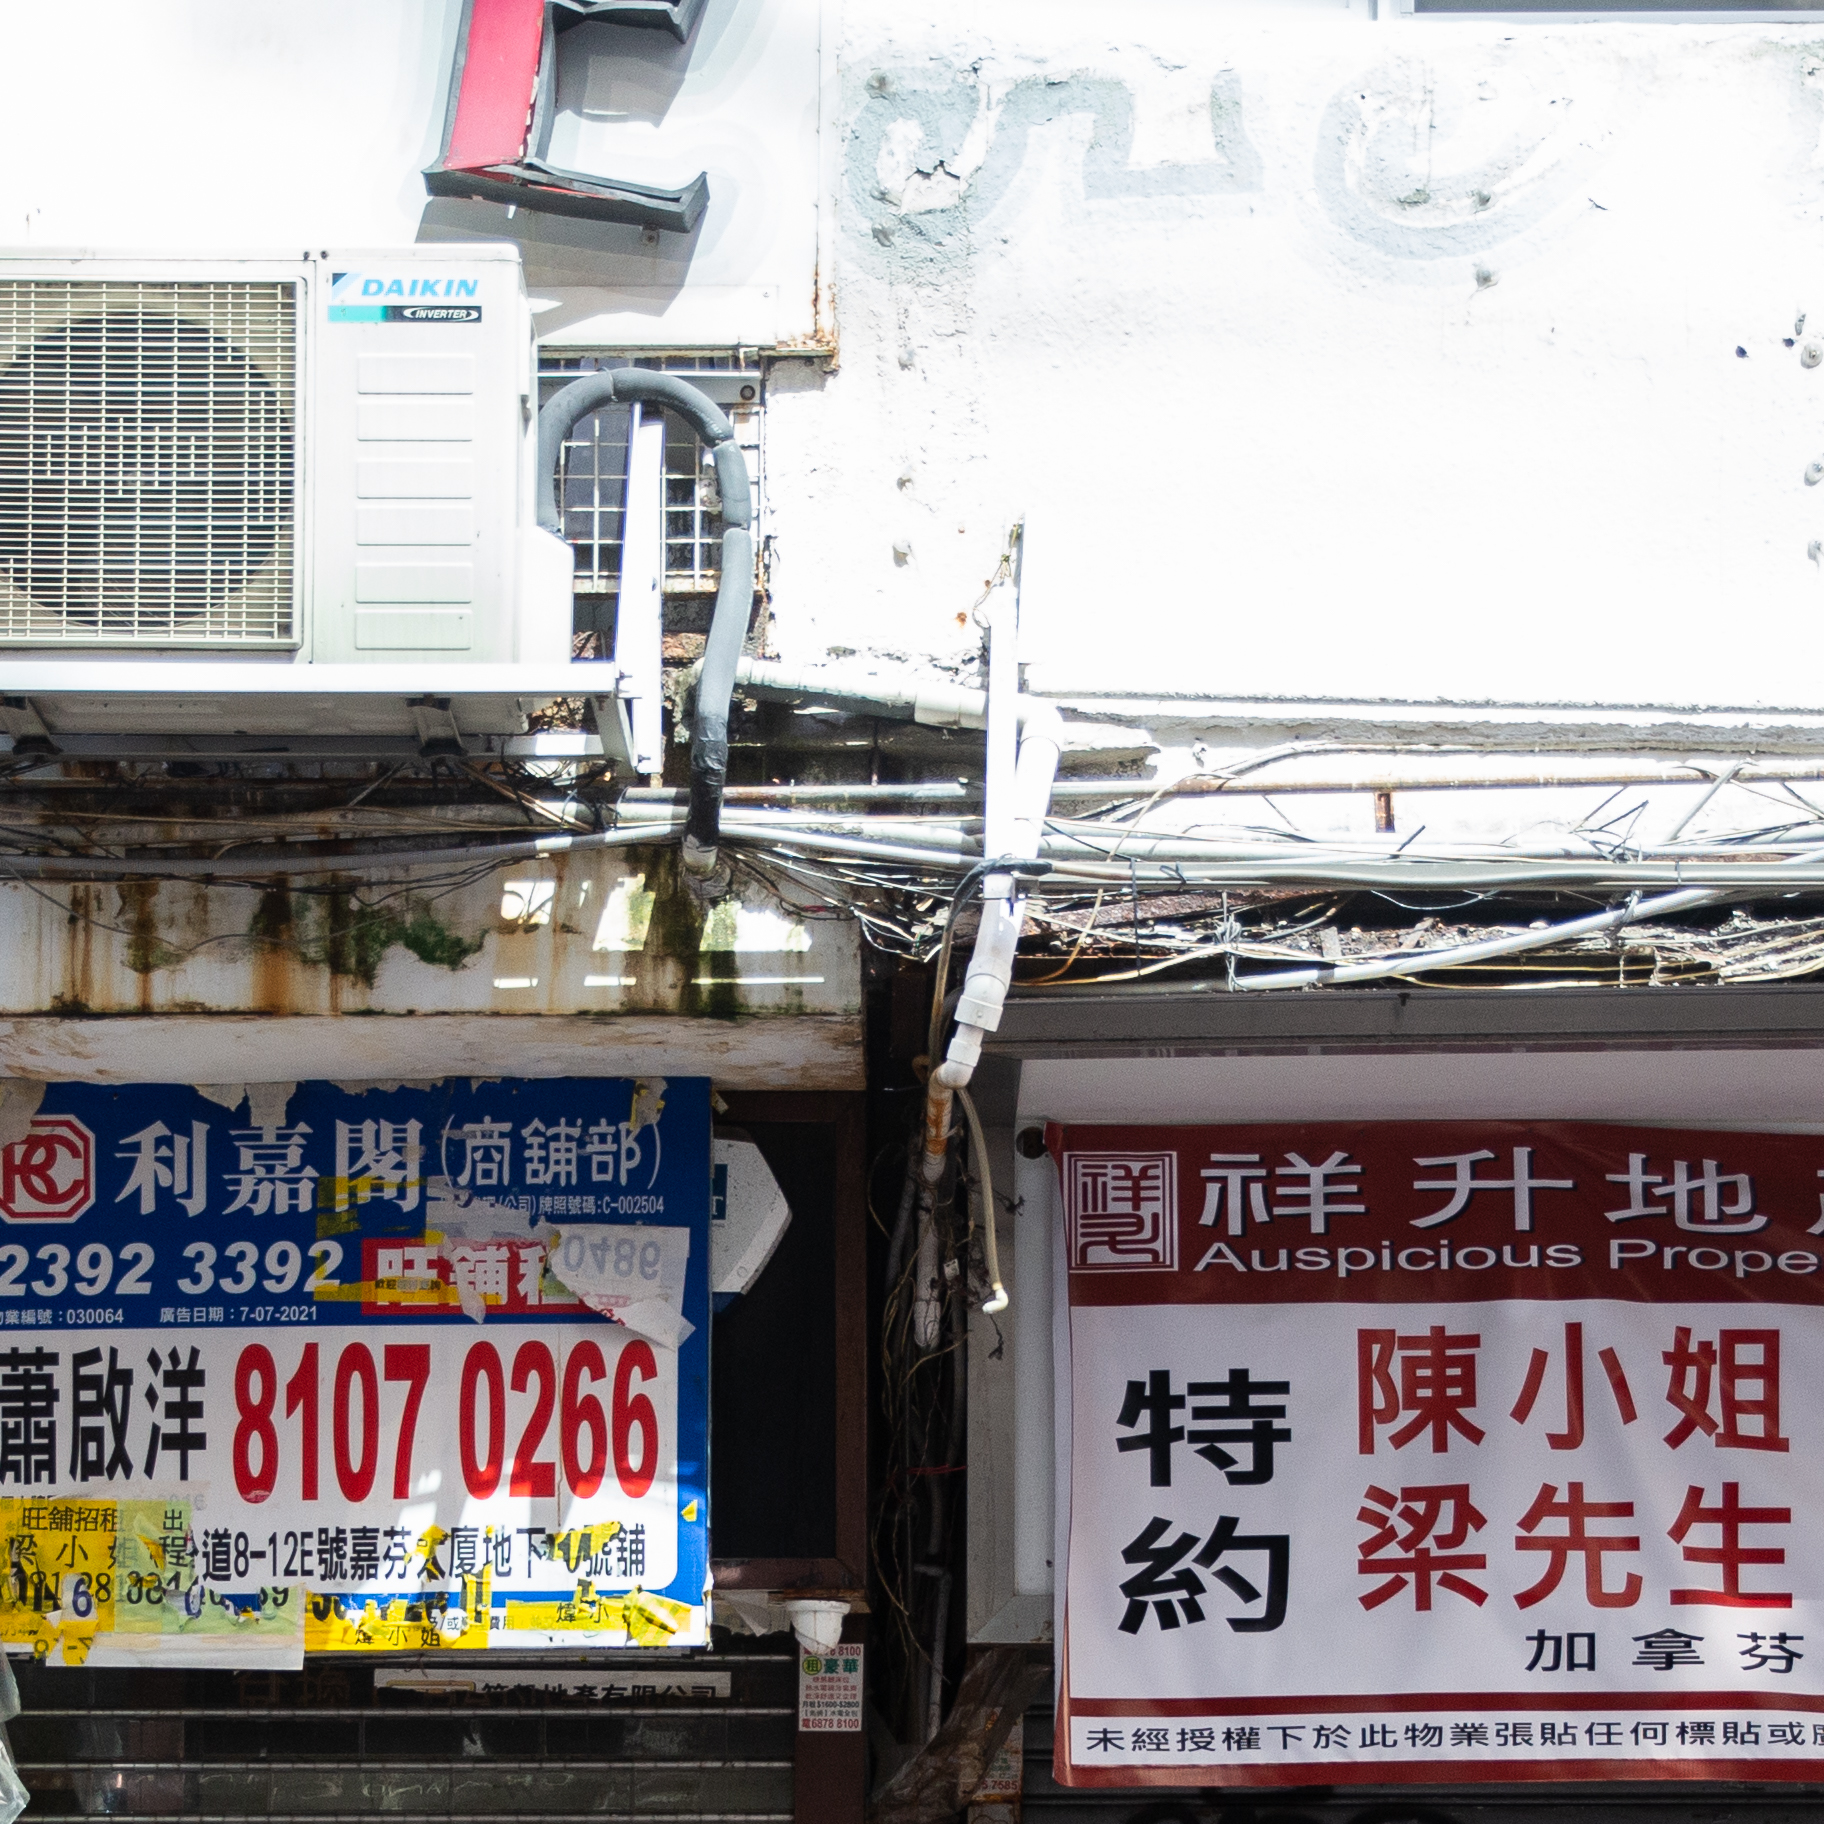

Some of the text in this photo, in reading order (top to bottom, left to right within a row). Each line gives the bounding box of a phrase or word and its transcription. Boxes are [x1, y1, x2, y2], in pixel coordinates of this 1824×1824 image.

[361, 279, 479, 297] DAIKIN
[414, 308, 470, 320] INVERTER
[114, 1117, 426, 1217] 利嘉閣
[177, 1240, 345, 1297] 3392
[1194, 1238, 1581, 1278] Auspicious
[232, 1341, 431, 1503] 8107
[459, 1340, 661, 1501] 0266
[1355, 1322, 1790, 1456] 陳小姐
[1355, 1481, 1794, 1612] 梁先生
